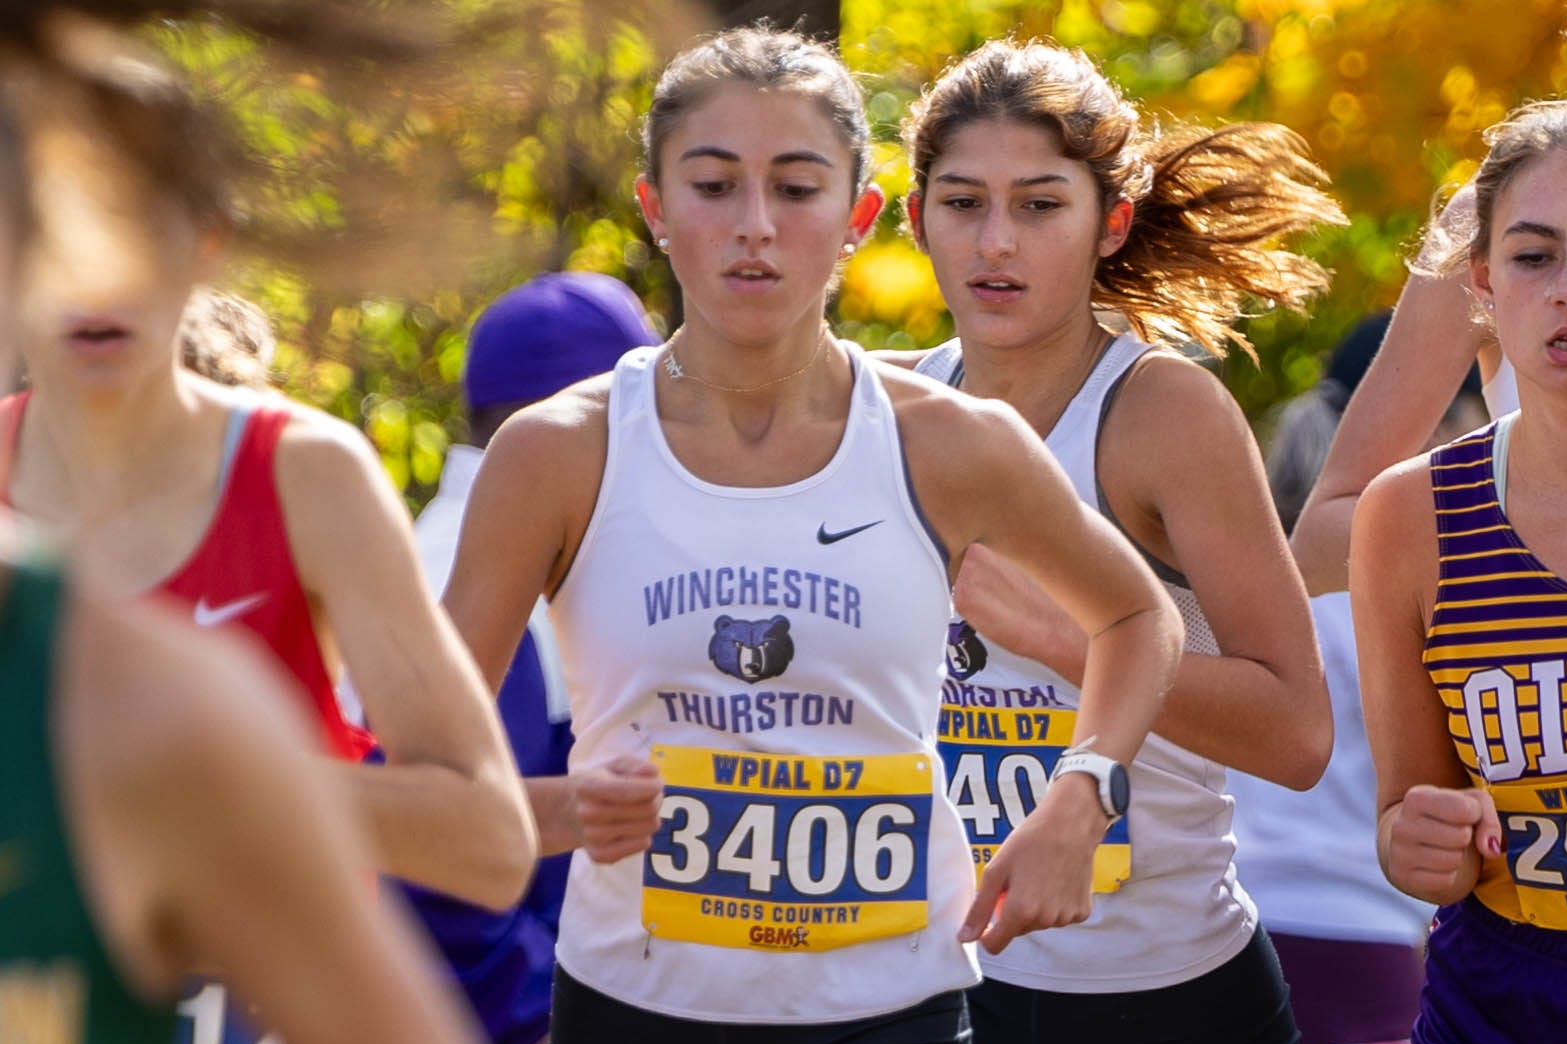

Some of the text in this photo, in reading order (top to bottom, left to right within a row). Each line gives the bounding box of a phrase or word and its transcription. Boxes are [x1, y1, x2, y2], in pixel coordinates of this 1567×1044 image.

[643, 566, 862, 629] WINCHESTER
[657, 691, 854, 734] THURSTON
[1014, 713, 1050, 741] D7
[712, 754, 864, 791] WPIAL D7
[948, 752, 1052, 836] 40
[650, 794, 917, 896] 3406
[701, 899, 860, 924] CROSS COUNTRY
